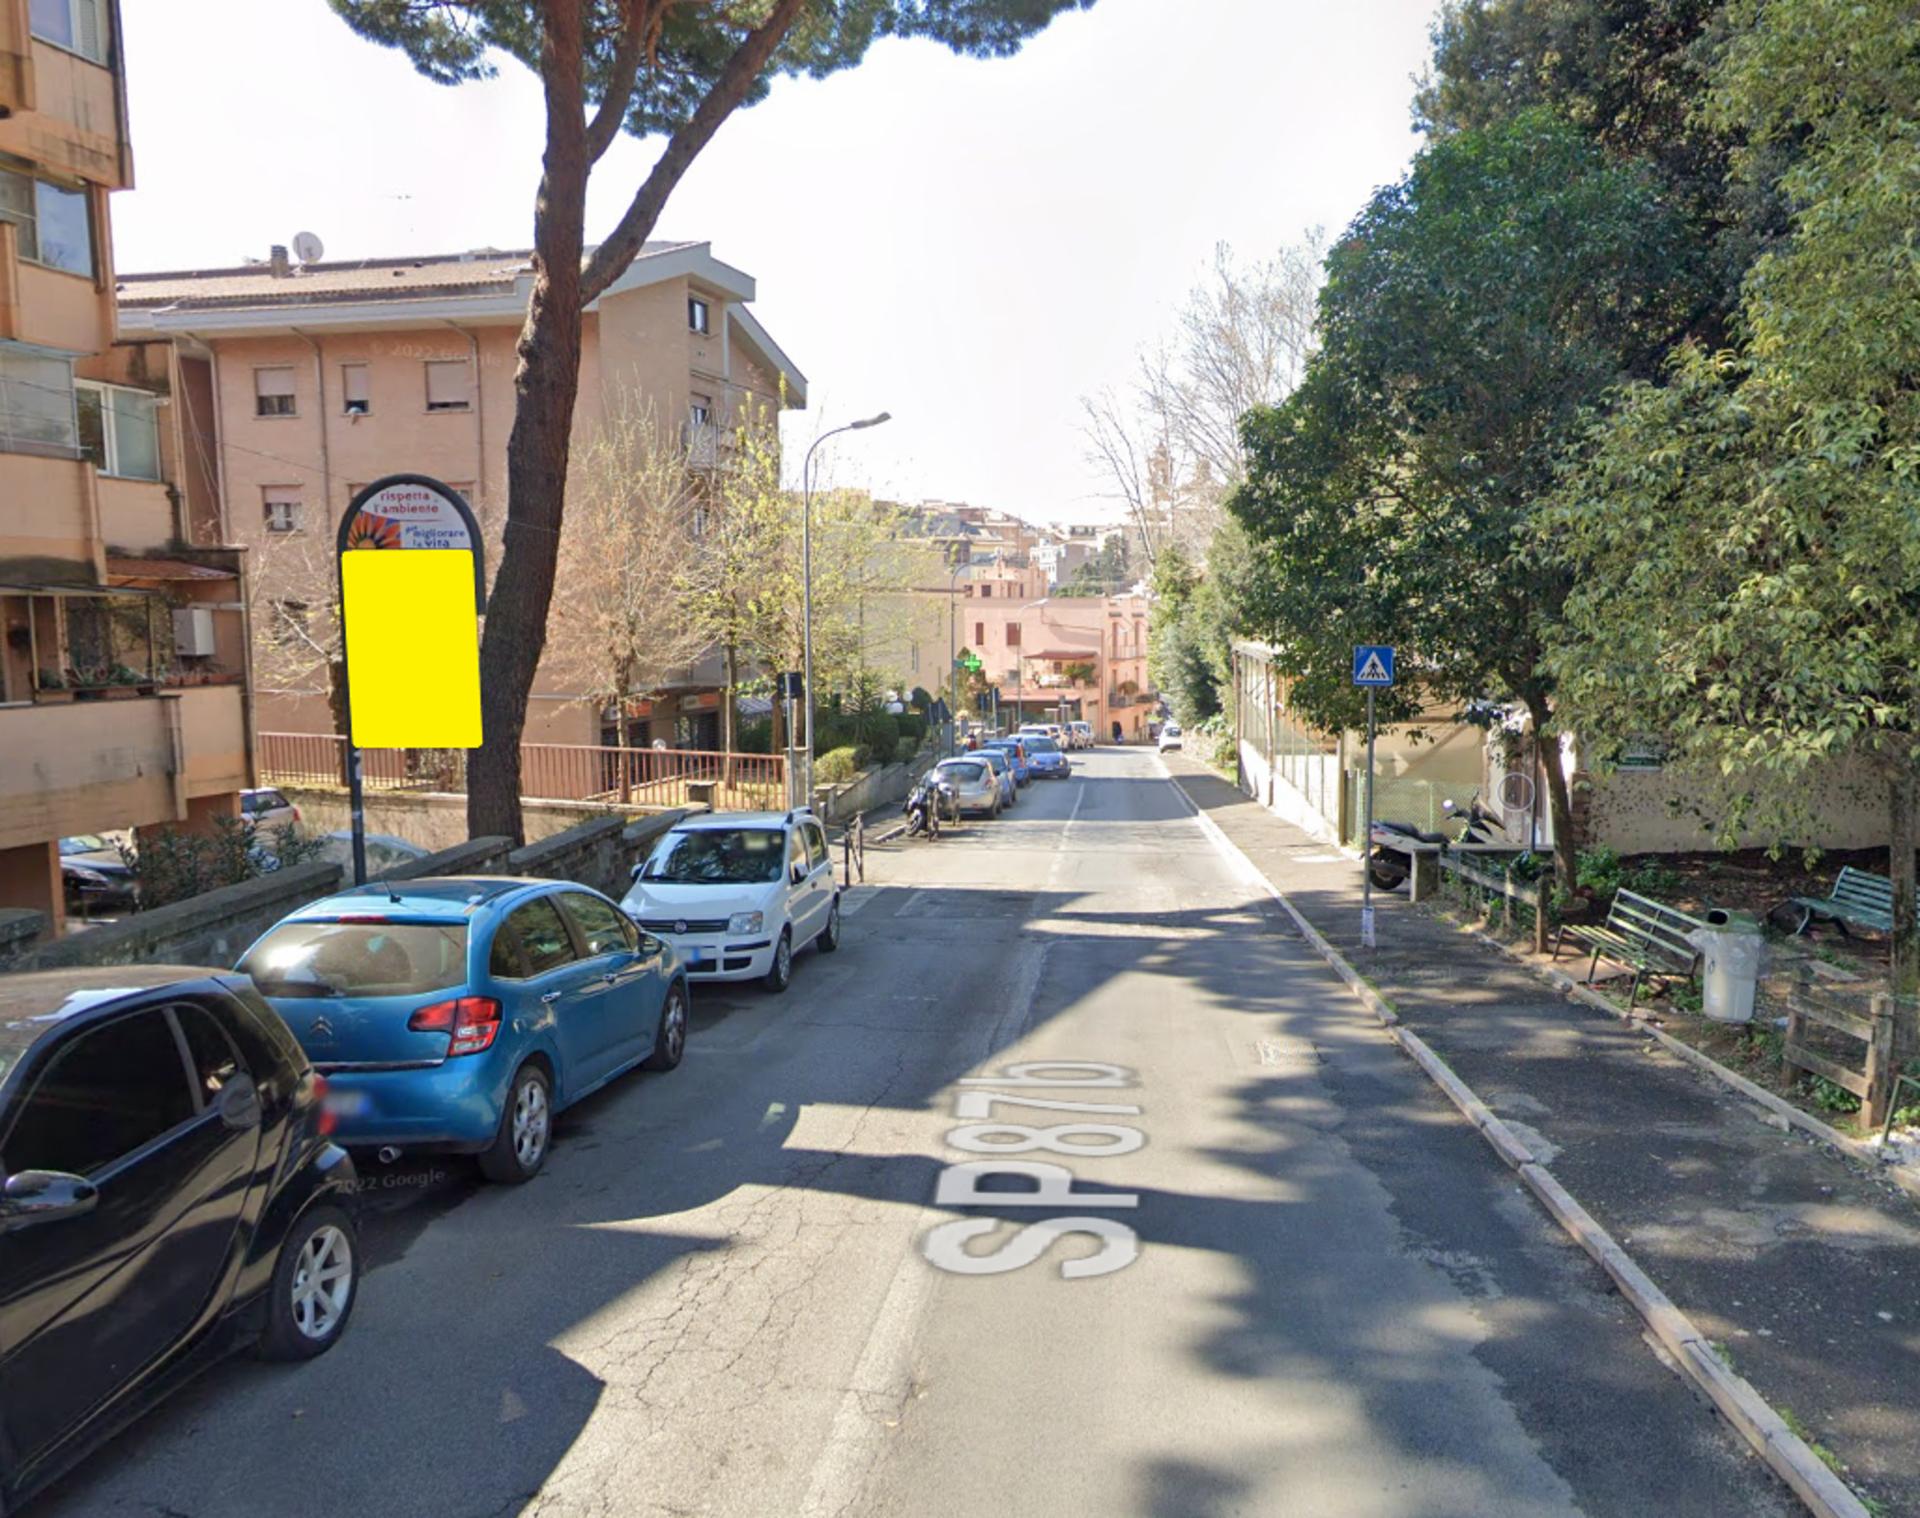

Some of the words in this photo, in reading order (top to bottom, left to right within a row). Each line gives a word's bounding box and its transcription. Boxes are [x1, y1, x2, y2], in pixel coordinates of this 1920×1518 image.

[380, 491, 430, 503] rispetta
[413, 527, 465, 539] migliorare
[425, 538, 450, 548] vita
